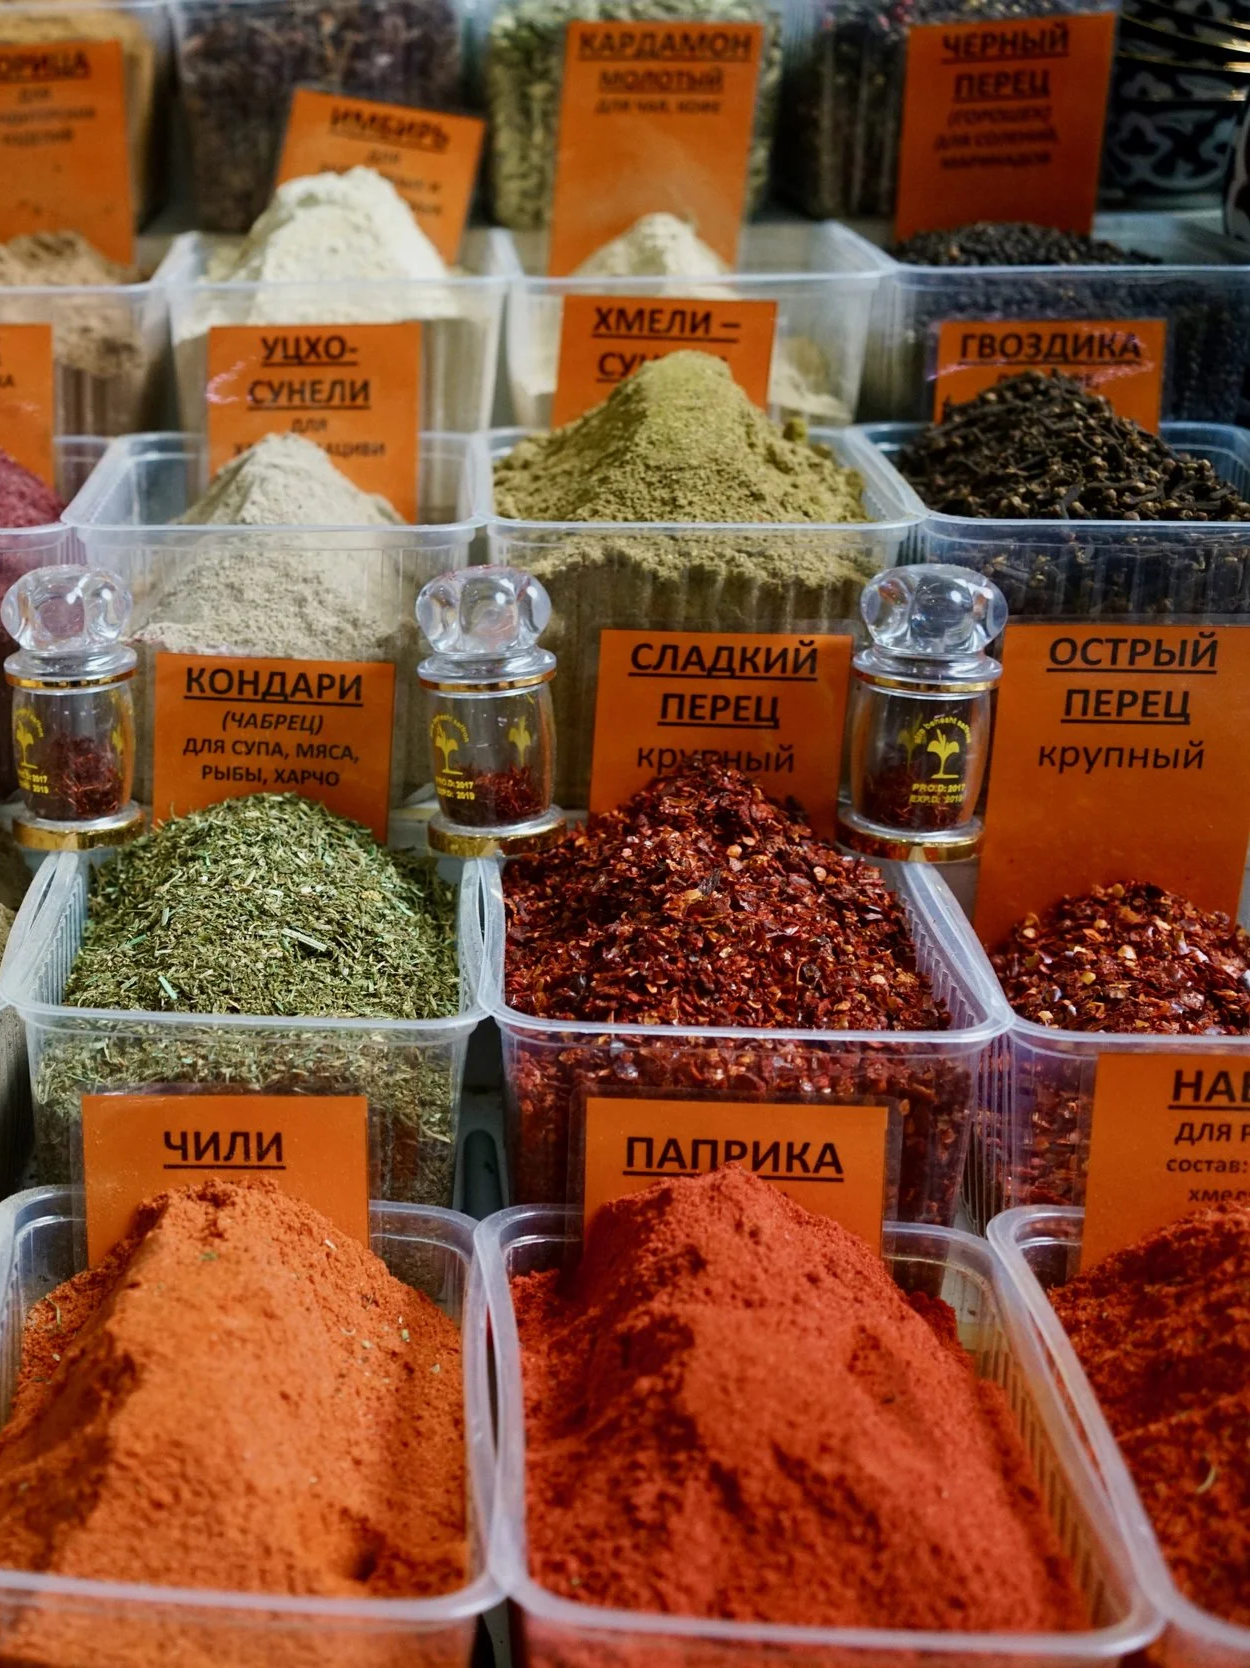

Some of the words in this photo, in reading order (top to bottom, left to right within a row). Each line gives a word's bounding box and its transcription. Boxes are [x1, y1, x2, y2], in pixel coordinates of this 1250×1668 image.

[579, 32, 753, 59] КАРДАМОН
[942, 22, 1069, 58] ЧЕРНЫЙ
[601, 67, 723, 91] МОЛОТЫЙ
[954, 69, 1051, 100] ПЕРЕЦ
[594, 306, 712, 335] ХМЕЛИ
[260, 335, 359, 365] УЦХО-
[960, 332, 1142, 362] ГВОЗДИКА
[249, 379, 371, 404] СУНЕЛИ
[291, 417, 328, 433] ДЛЯ
[631, 640, 818, 677] СЛАДКИЙ
[1049, 631, 1218, 668] ОСТРЫЙ
[186, 667, 362, 700] КОНДАРИ
[660, 693, 779, 728] ПЕРЕЦ
[1064, 689, 1190, 724] ПЕРЕЦ
[222, 710, 323, 735] (ЧАБРЕЦ)
[183, 738, 225, 756] ДЛЯ
[232, 740, 289, 760] СУПА,
[296, 743, 359, 763] МЯСА,
[1038, 740, 1204, 774] крупный
[201, 765, 268, 785] РЫБЫ,
[274, 768, 340, 787] ХАРЧО
[163, 1130, 283, 1162] ЧИЛИ
[1174, 1122, 1232, 1145] ДЛЯ
[626, 1136, 844, 1174] ПАПРИКА
[1166, 1159, 1248, 1173] состав:
